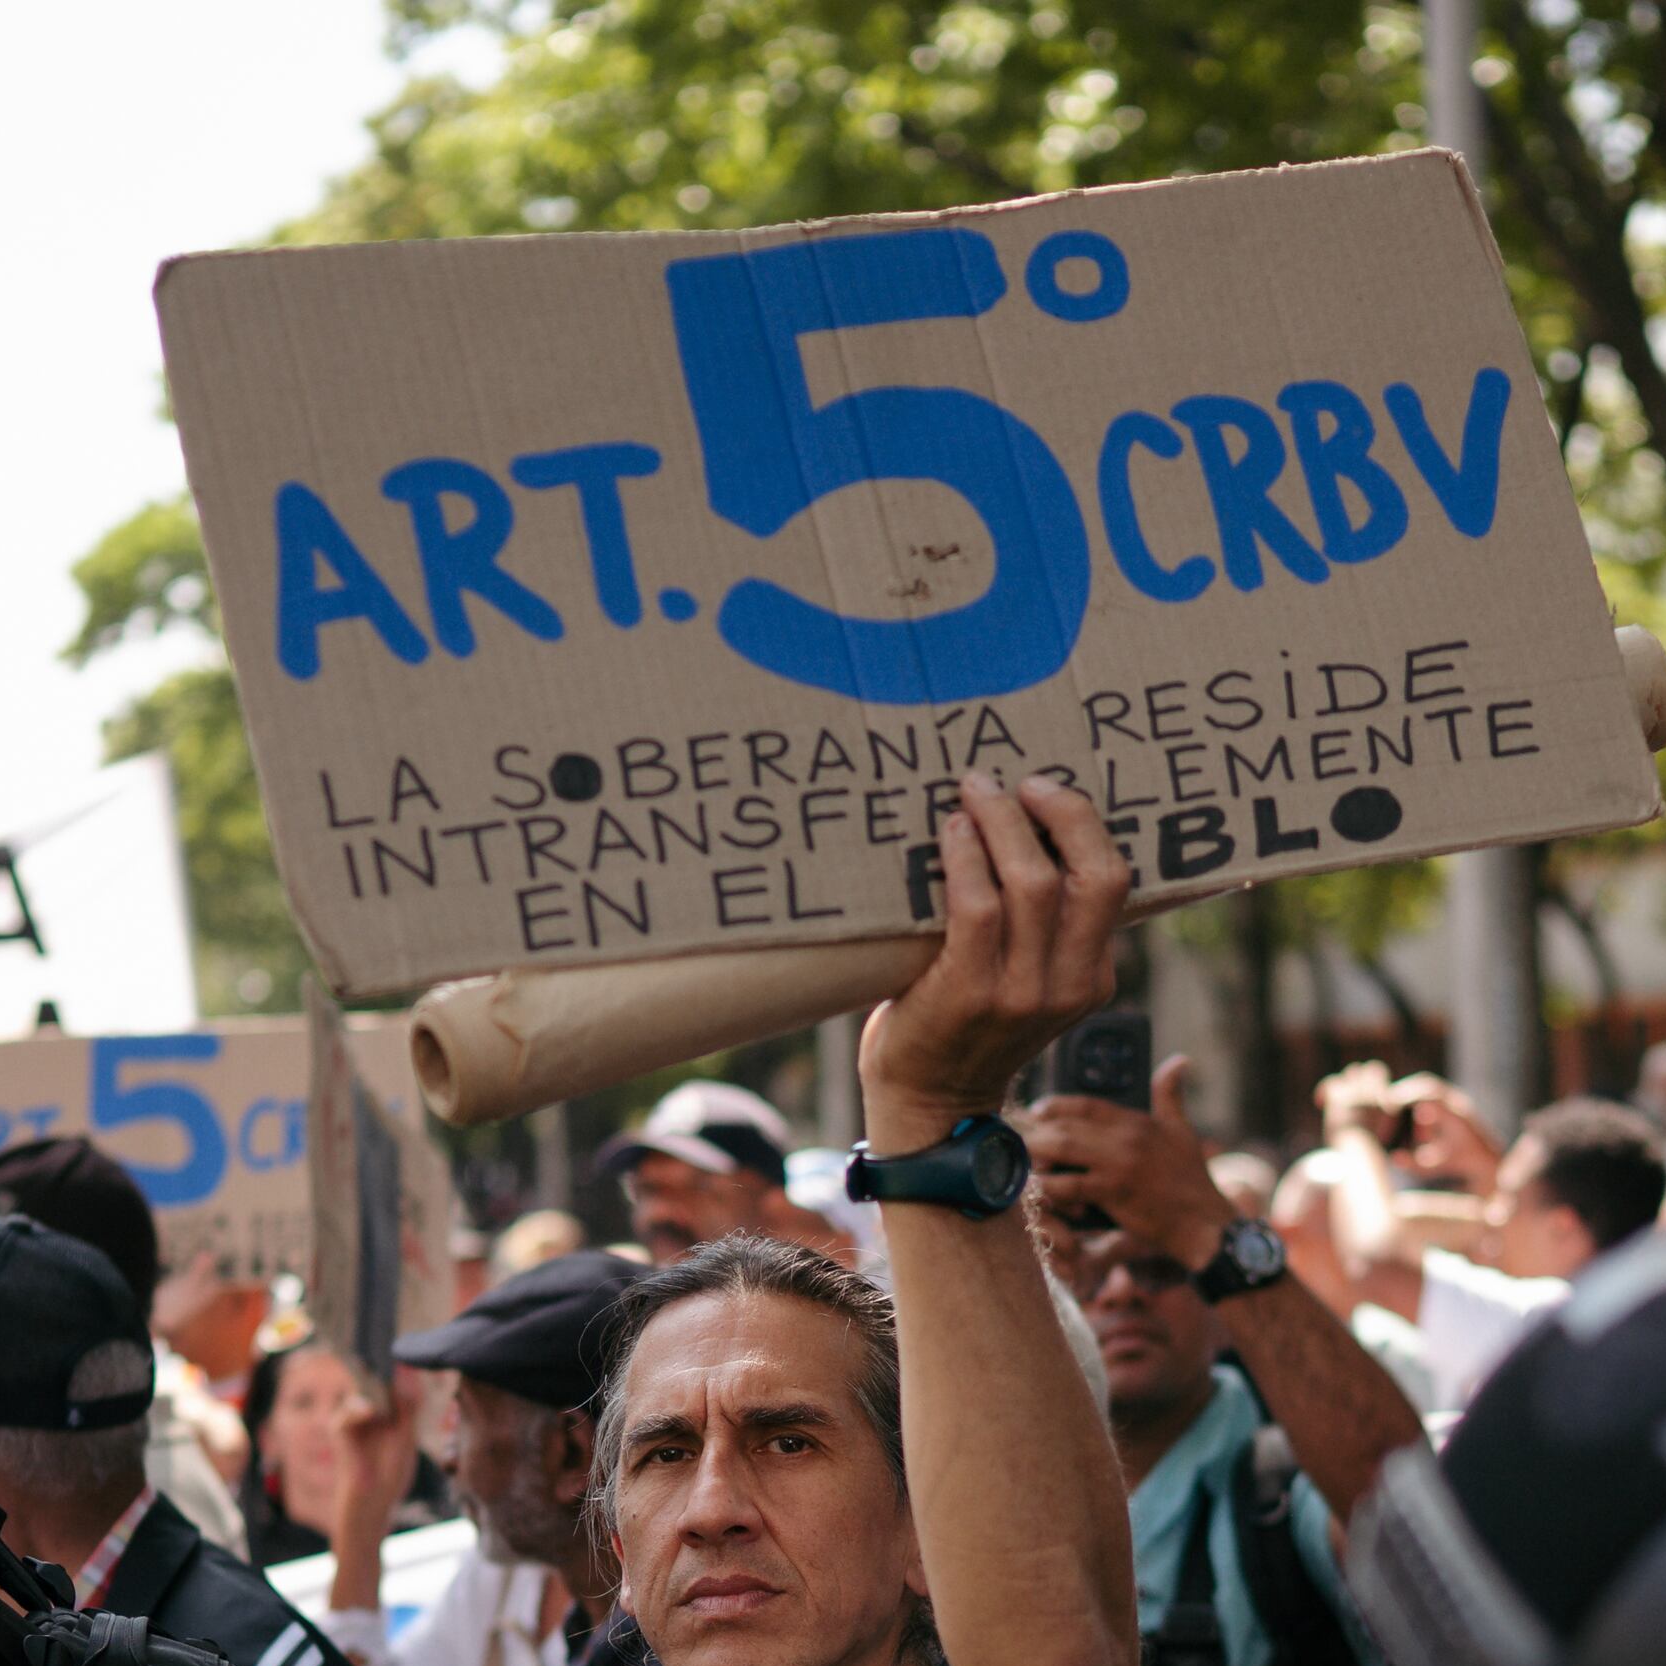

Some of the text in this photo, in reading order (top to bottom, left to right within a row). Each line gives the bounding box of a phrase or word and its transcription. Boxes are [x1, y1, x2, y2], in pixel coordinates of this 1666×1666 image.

[275, 441, 699, 680] ART.
[1097, 367, 1511, 603] CRBV
[320, 757, 440, 830] LA
[515, 784, 1403, 952] EN EL PBLO
[89, 1034, 230, 1208] 5
